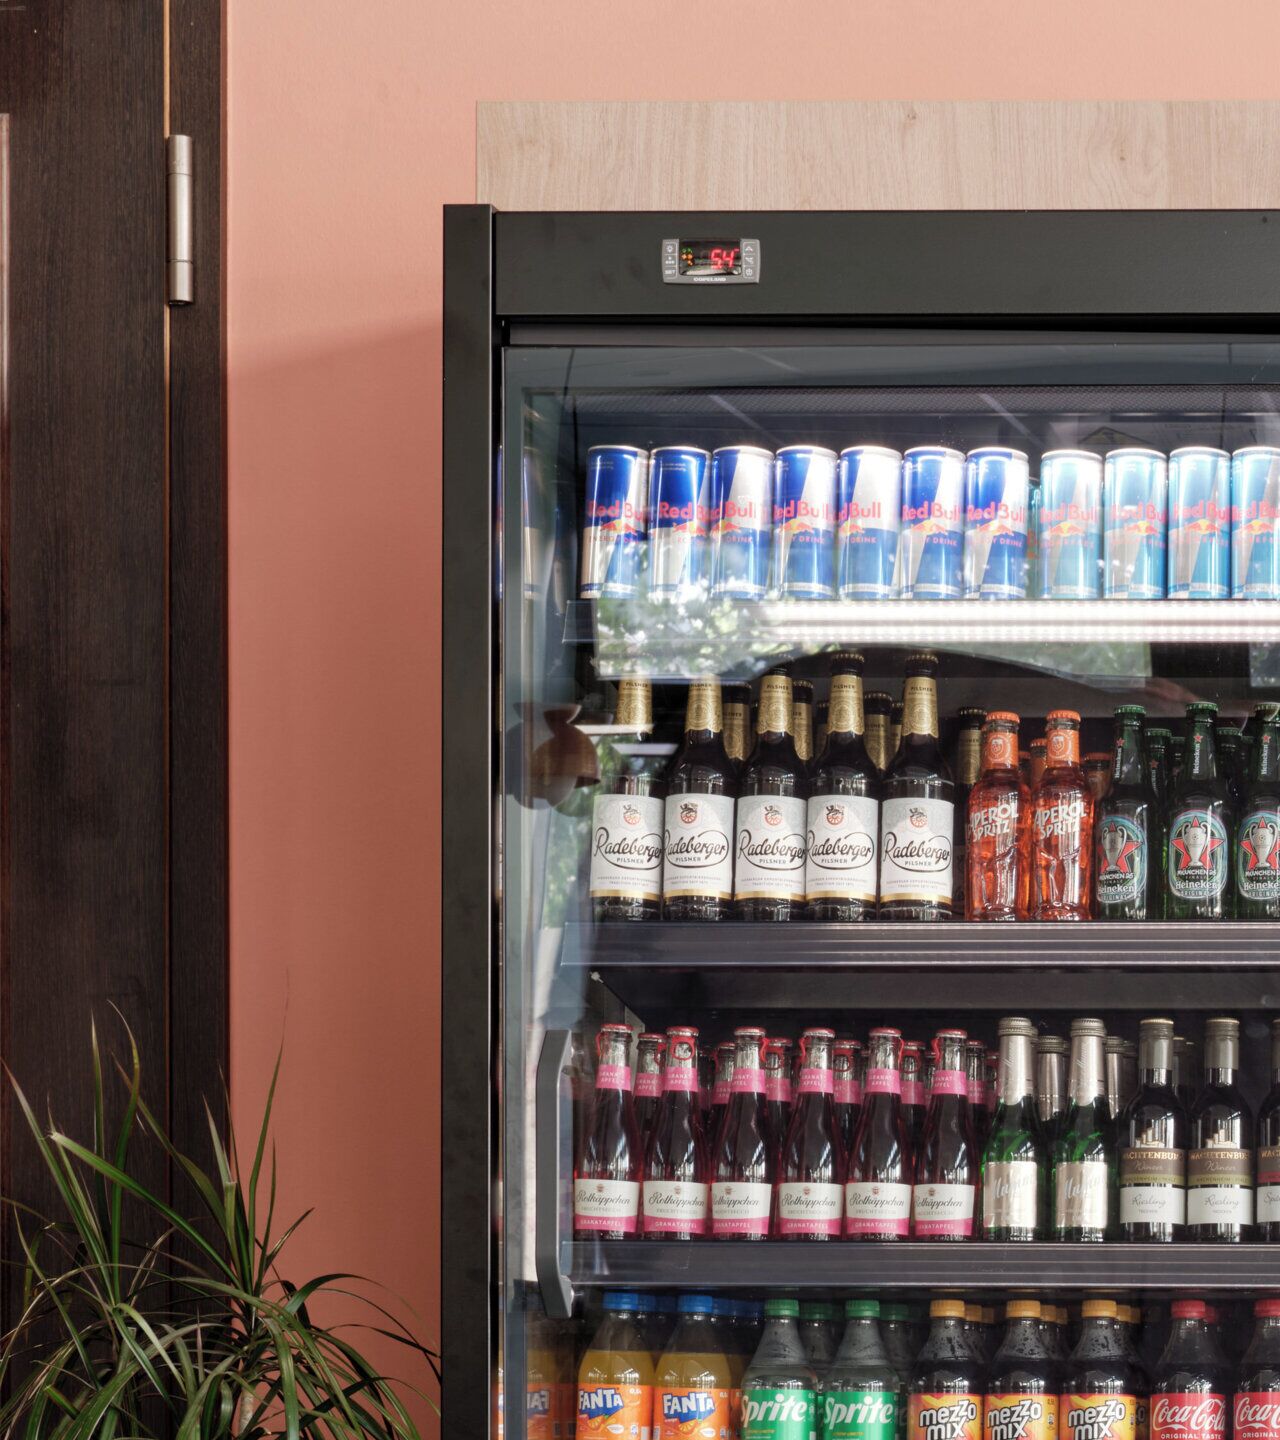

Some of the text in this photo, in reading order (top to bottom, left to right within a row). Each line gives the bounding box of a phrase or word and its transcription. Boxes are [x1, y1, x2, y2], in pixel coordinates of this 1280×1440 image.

[1035, 802, 1087, 829] APEROL
[973, 820, 1010, 842] SPRITZ
[1040, 819, 1079, 839] SPRITZ
[883, 832, 950, 865] Radeberger
[1176, 881, 1218, 890] Heineken
[578, 1388, 623, 1412] FANTA
[663, 1392, 715, 1414] FANTA
[741, 1393, 806, 1428] Sprite
[823, 1395, 894, 1427] Sprite
[1153, 1398, 1225, 1431] Coca-Cola
[1160, 1432, 1222, 1440] ORIGINAL TASTE
